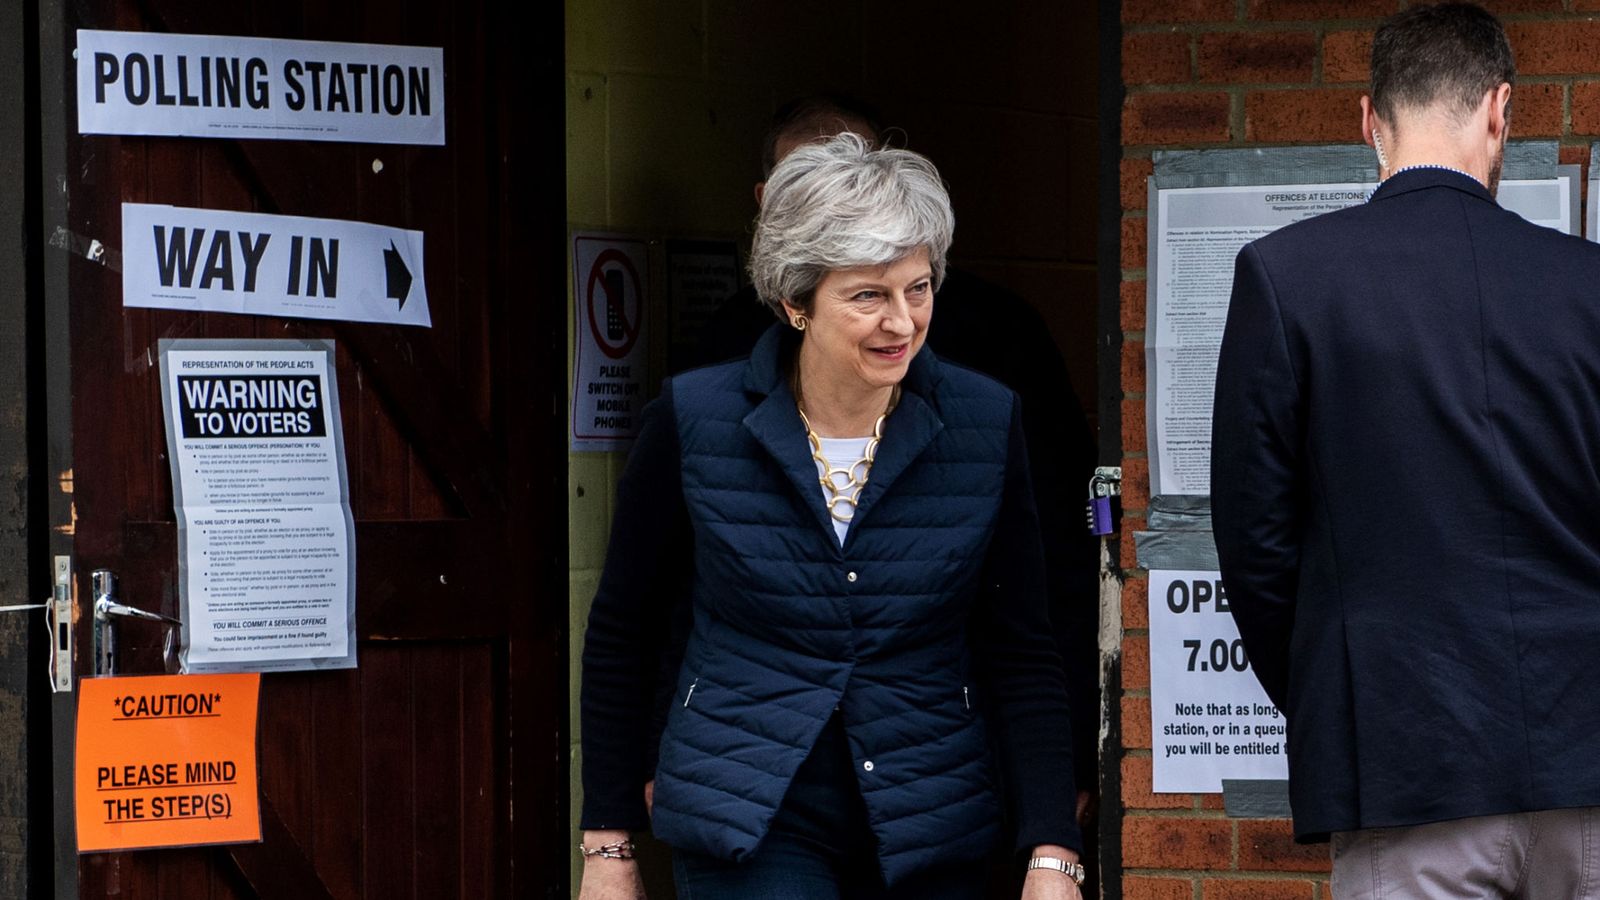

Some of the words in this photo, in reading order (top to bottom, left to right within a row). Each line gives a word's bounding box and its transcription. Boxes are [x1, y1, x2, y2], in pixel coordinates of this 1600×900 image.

[95, 52, 269, 110] POLLING
[284, 60, 431, 116] STATION
[1265, 194, 1306, 202] OFFENCES
[1320, 192, 1365, 200] ELECTIONS
[153, 225, 272, 293] WAY
[287, 236, 340, 298] IN
[182, 361, 243, 369] REPRESENTATION
[600, 366, 630, 378] PLEASE
[183, 380, 317, 408] WARNING
[588, 382, 622, 394] SWITCH
[597, 400, 630, 411] MOBILE
[194, 412, 224, 434] TO
[229, 412, 311, 434] VOTERS
[594, 417, 631, 428] PHONES
[1166, 580, 1232, 614] OPE
[242, 620, 267, 629] COMMIT
[274, 619, 299, 627] SERIOUS
[300, 617, 327, 626] OFFENCE
[1176, 703, 1203, 716] Note
[1207, 703, 1231, 716] that
[1236, 706, 1250, 716] as
[1254, 703, 1279, 718] long
[1164, 723, 1208, 737] station,
[1213, 726, 1225, 736] or
[1228, 723, 1240, 736] in
[1244, 726, 1251, 736] a
[1255, 726, 1286, 739] queu
[1166, 745, 1186, 757] you
[1190, 742, 1211, 754] will
[1216, 742, 1230, 754] be
[1234, 742, 1279, 755] entitled
[98, 763, 178, 788] PLEASE
[186, 761, 236, 783] MIND
[104, 798, 144, 820] THE
[152, 793, 232, 820] STEP(S)
